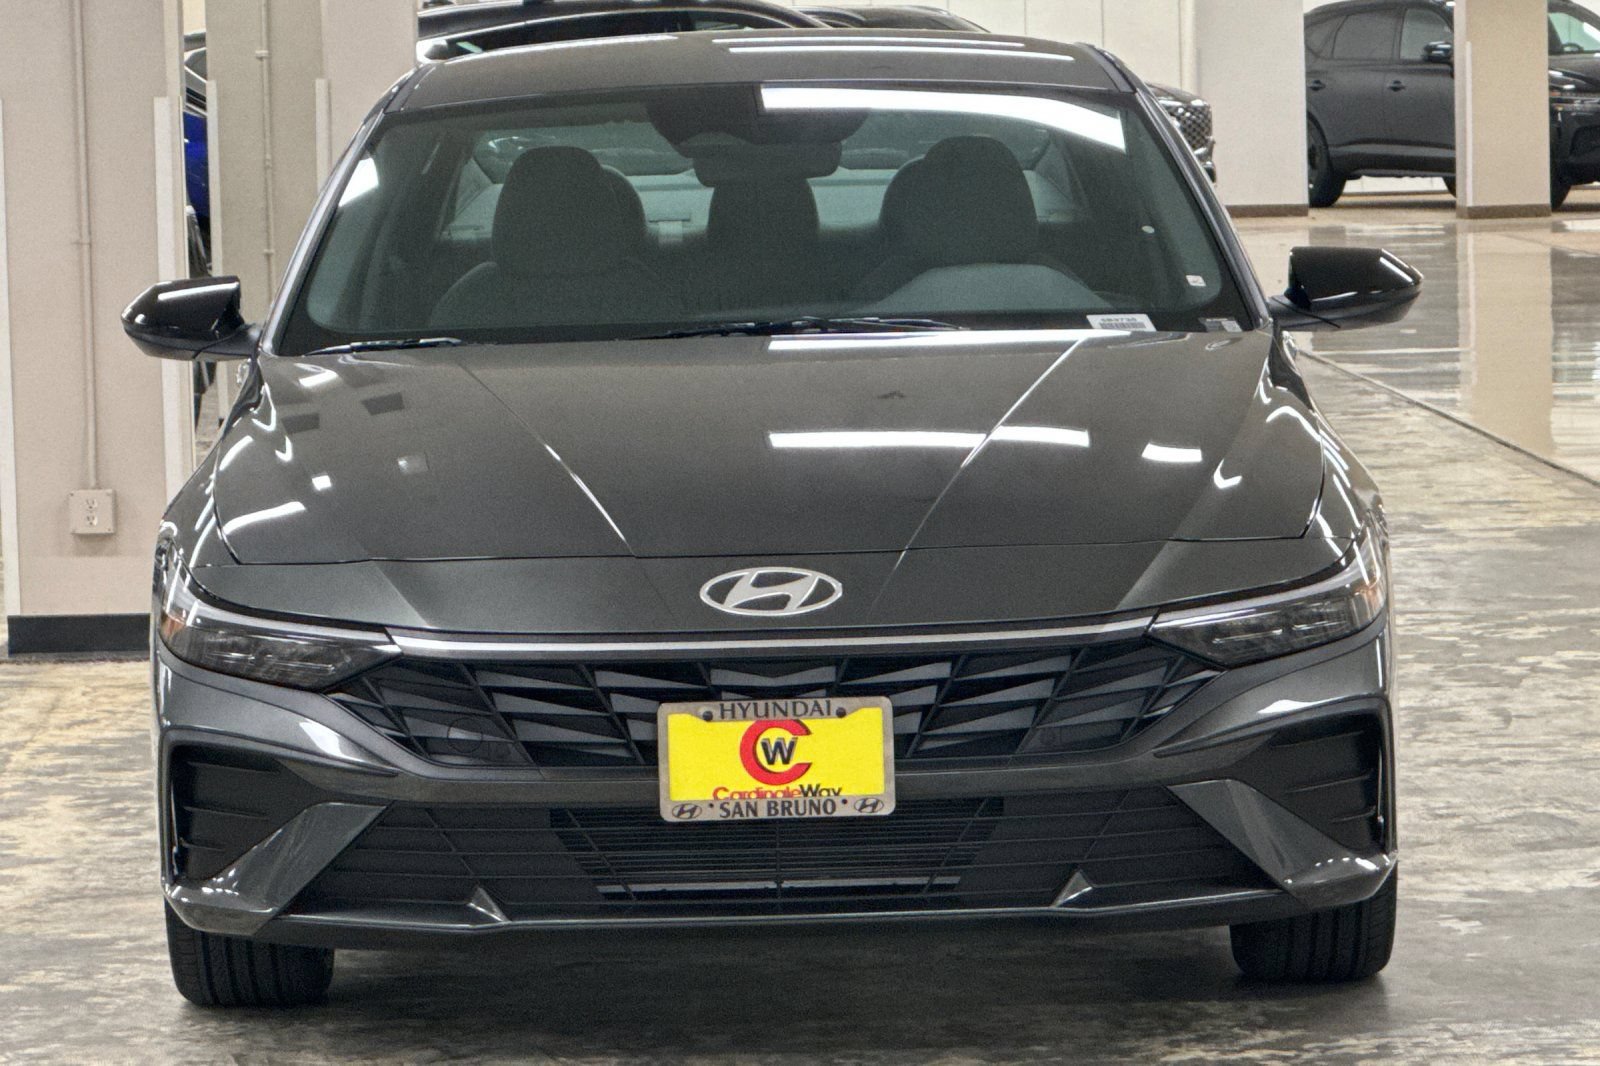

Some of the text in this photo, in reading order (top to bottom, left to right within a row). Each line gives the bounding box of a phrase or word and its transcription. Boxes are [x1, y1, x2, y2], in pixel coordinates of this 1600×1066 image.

[719, 700, 831, 720] HYUNDAI
[719, 798, 836, 818] SAN BRUNO
